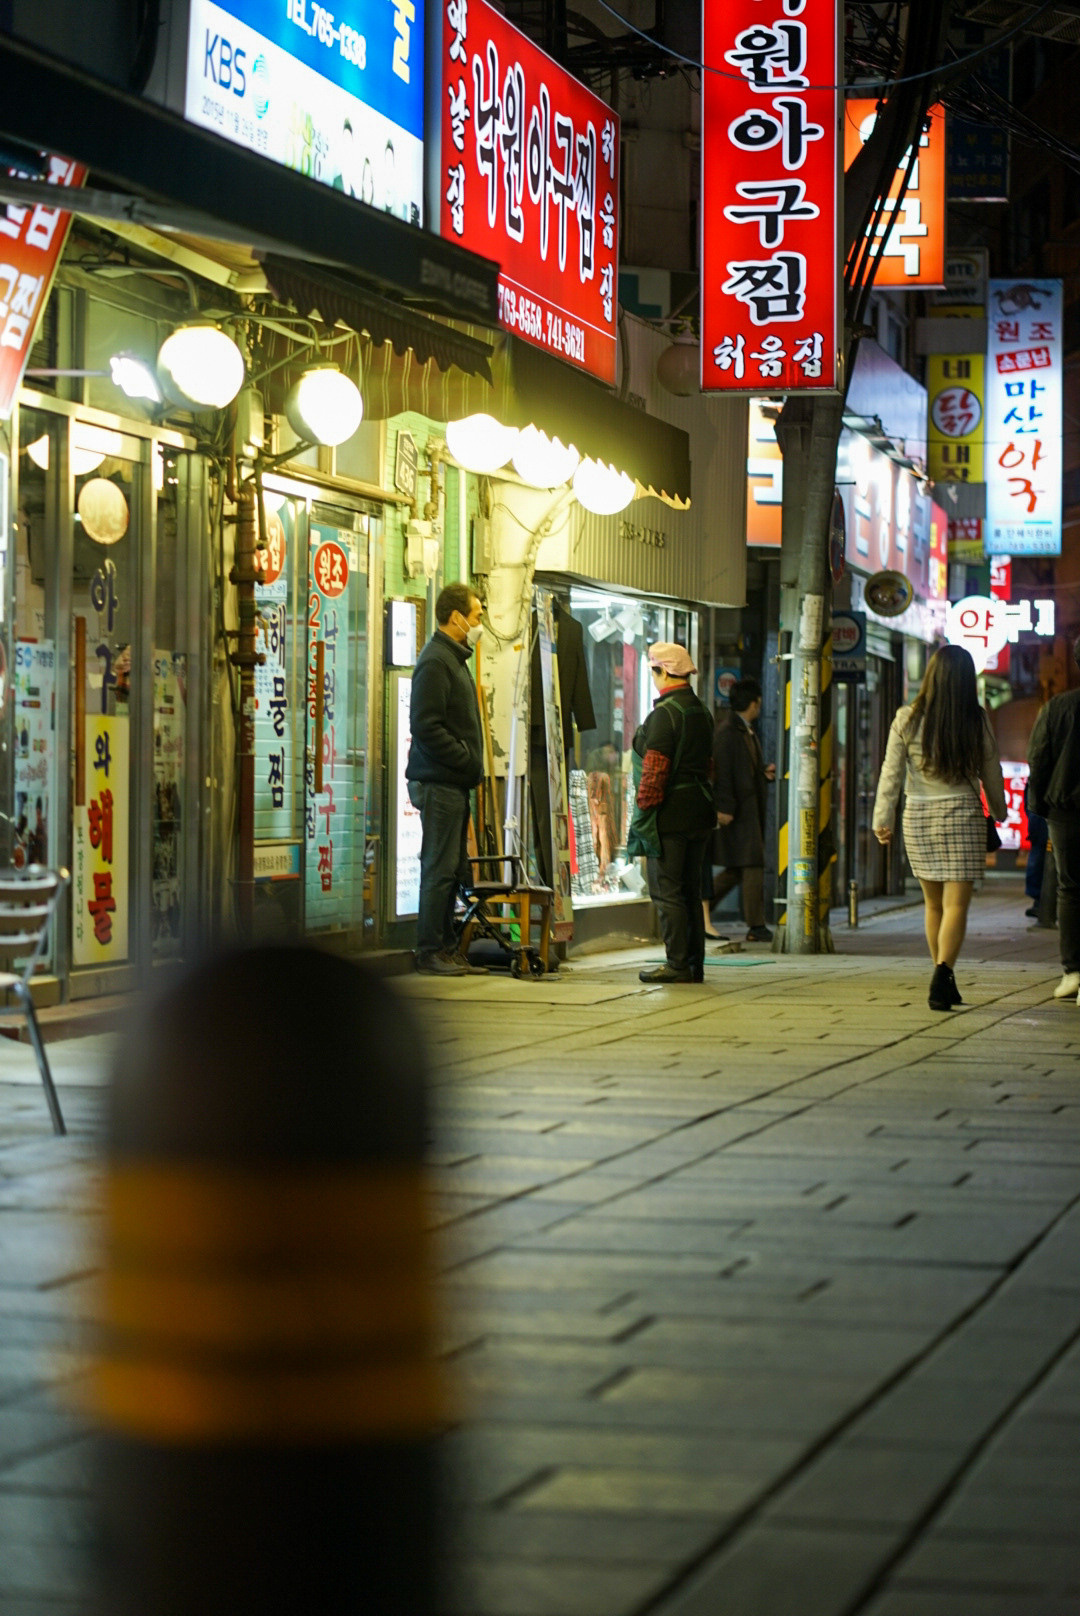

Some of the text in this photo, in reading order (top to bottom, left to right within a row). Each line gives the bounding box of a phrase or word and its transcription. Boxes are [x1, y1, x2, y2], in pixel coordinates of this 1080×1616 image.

[204, 28, 247, 98] KBS
[472, 38, 597, 285] 낙원아구찜
[721, 0, 825, 327] 원아구찜
[712, 332, 825, 379] 처음집
[995, 321, 1056, 343] 원조
[999, 348, 1049, 371] 소문난
[1003, 378, 1046, 434] 마산
[318, 547, 345, 591] 원조
[959, 608, 995, 648] 약
[268, 602, 288, 809] 해물찜
